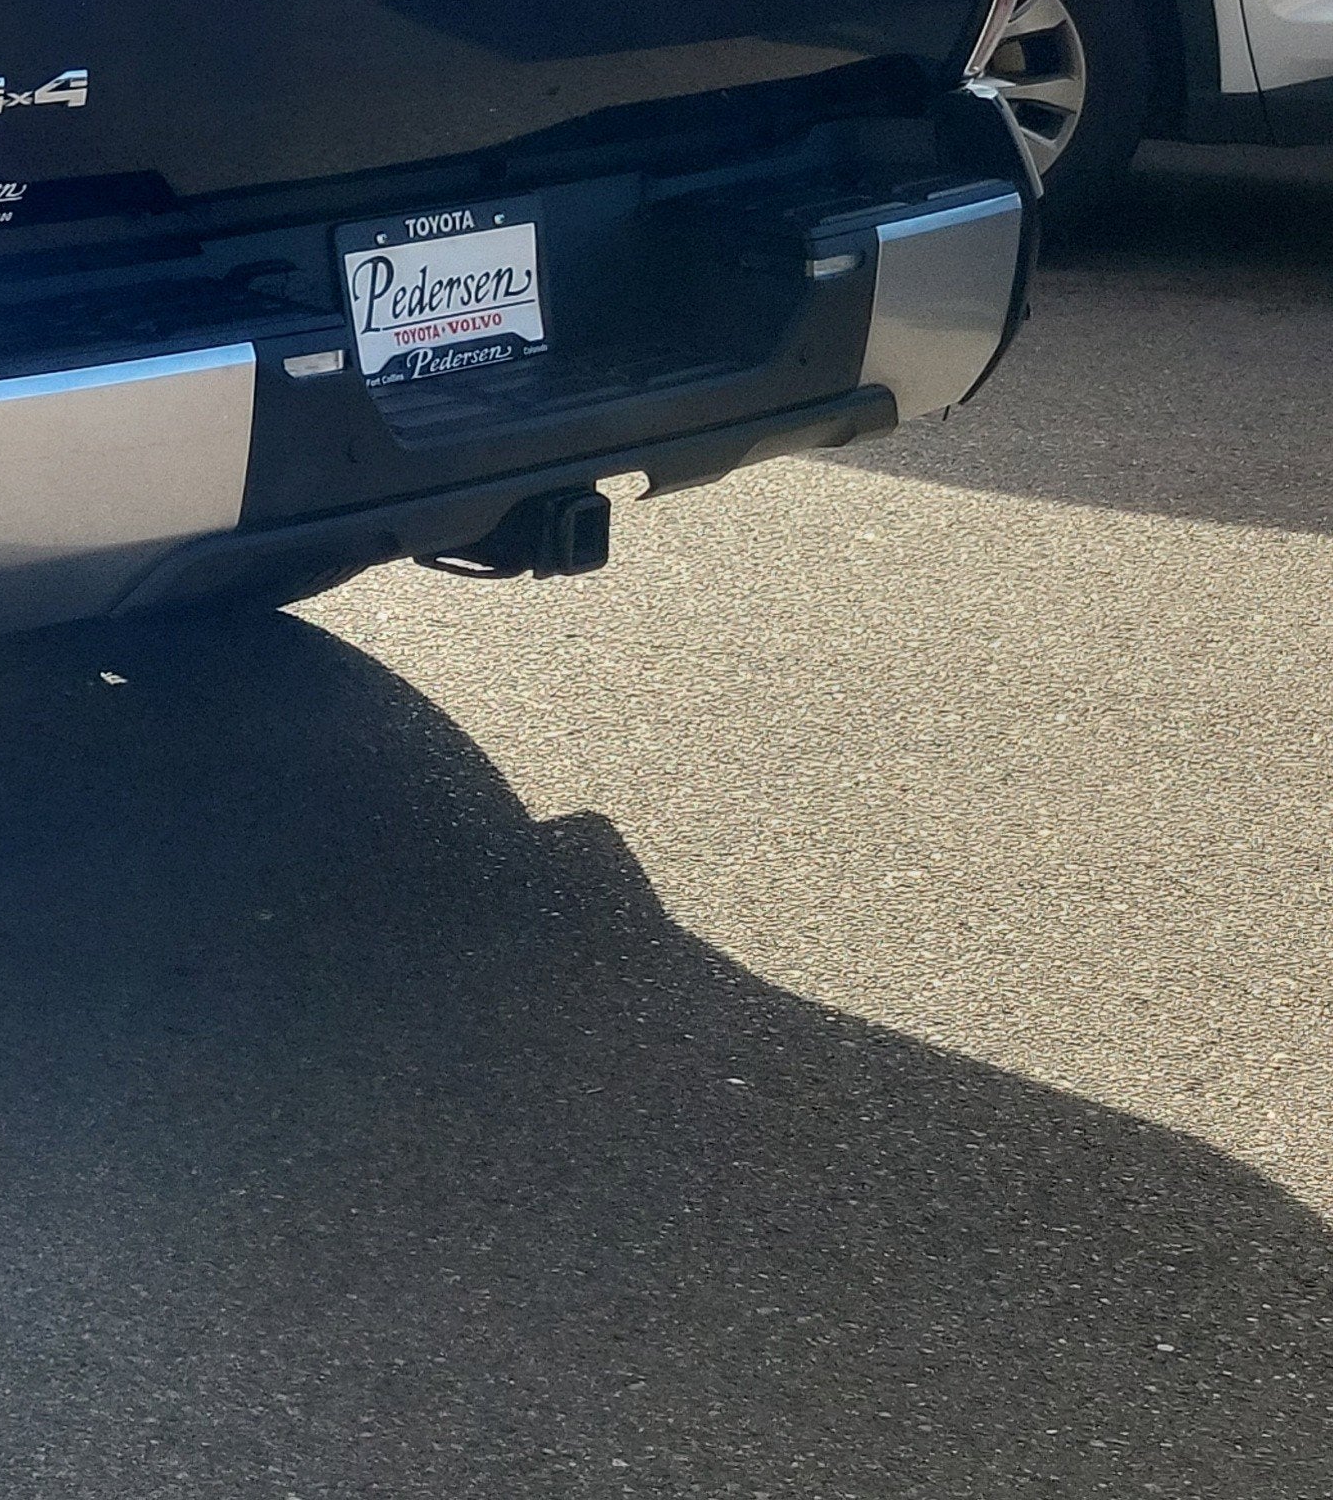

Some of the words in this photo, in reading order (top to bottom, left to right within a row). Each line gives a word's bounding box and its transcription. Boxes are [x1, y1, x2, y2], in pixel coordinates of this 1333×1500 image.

[405, 210, 475, 239] TOYOTA
[352, 255, 533, 336] Pedersen
[394, 325, 441, 347] TOYOTA
[446, 313, 503, 334] VOLVO
[406, 344, 513, 380] Pedersen
